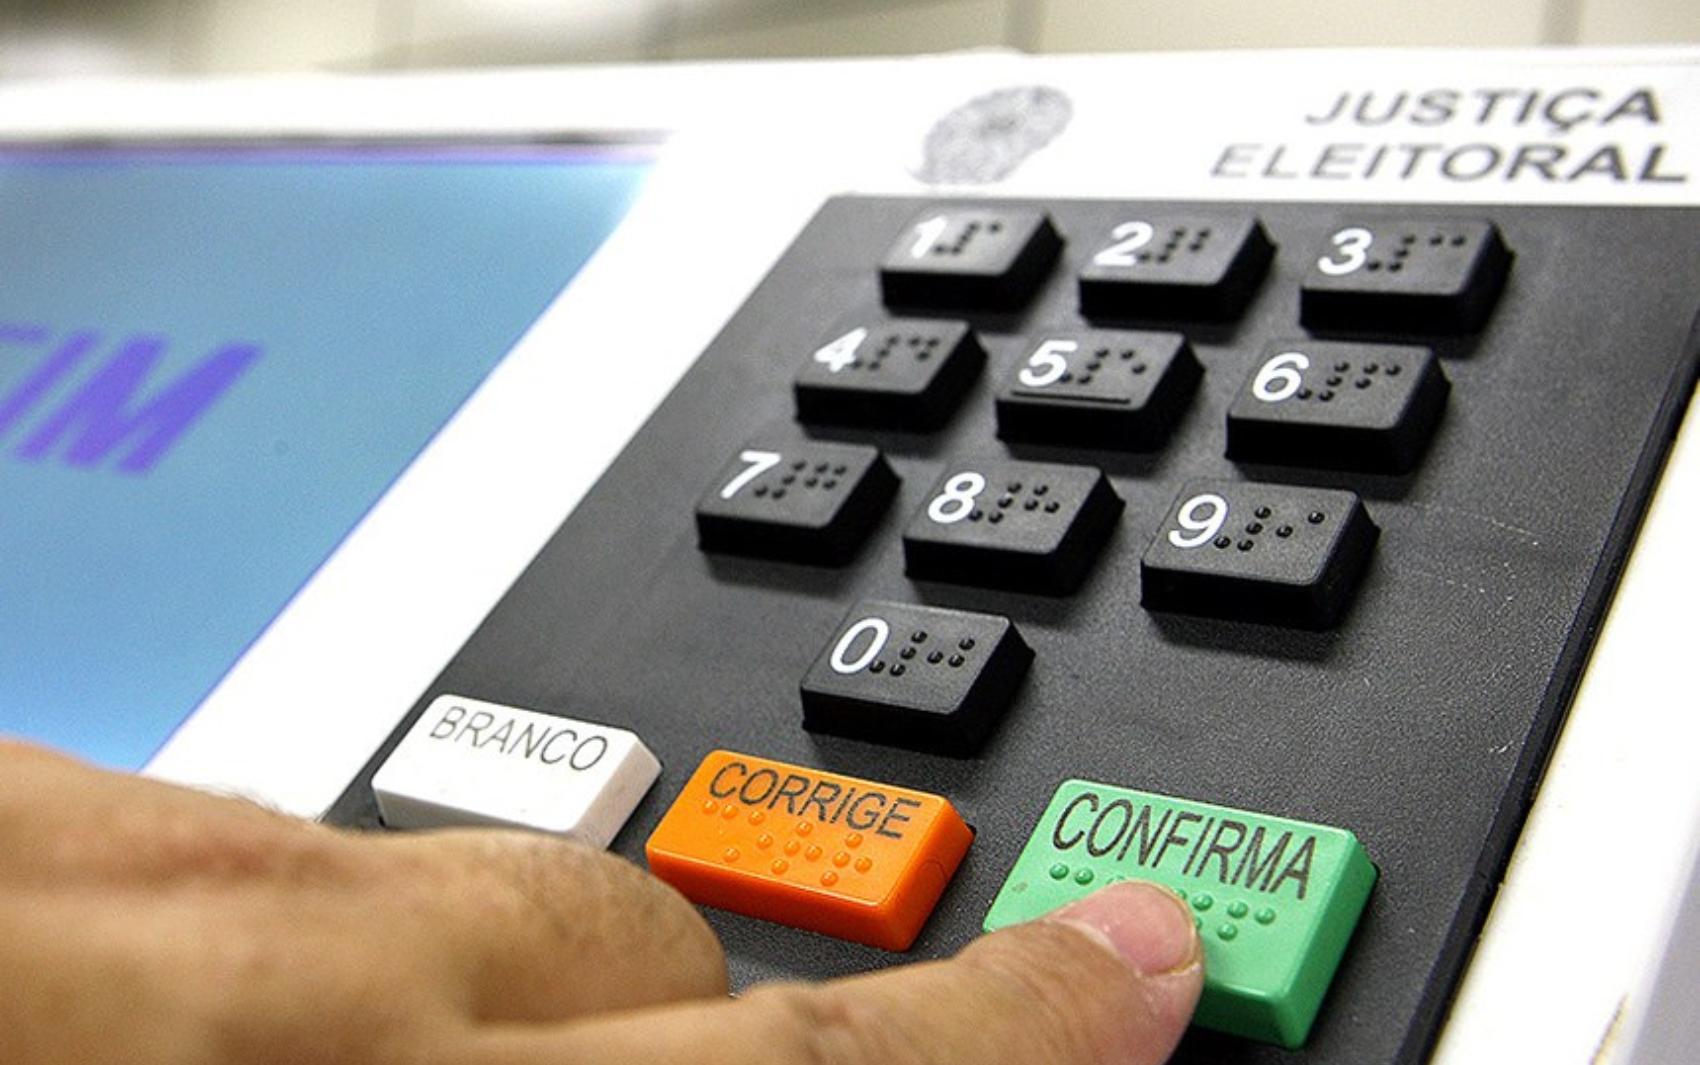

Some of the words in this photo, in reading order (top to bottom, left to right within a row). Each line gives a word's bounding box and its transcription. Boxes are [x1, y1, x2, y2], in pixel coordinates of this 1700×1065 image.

[1304, 87, 1663, 134] JUSTIÇA
[1210, 143, 1689, 184] ELEITORAL
[905, 218, 949, 258] 1
[1093, 222, 1155, 267] 2
[1317, 227, 1374, 277] 3
[813, 326, 869, 373] 4
[1018, 340, 1078, 388] 5
[0, 322, 265, 477] IM
[1251, 351, 1310, 403] 6
[720, 449, 783, 500] 7
[927, 471, 986, 524] 8
[1168, 493, 1229, 549] 9
[830, 617, 890, 674] 0
[429, 705, 608, 771] BRANCO
[708, 761, 922, 840] CORRIGE
[1052, 792, 1317, 900] CONFIRMA
